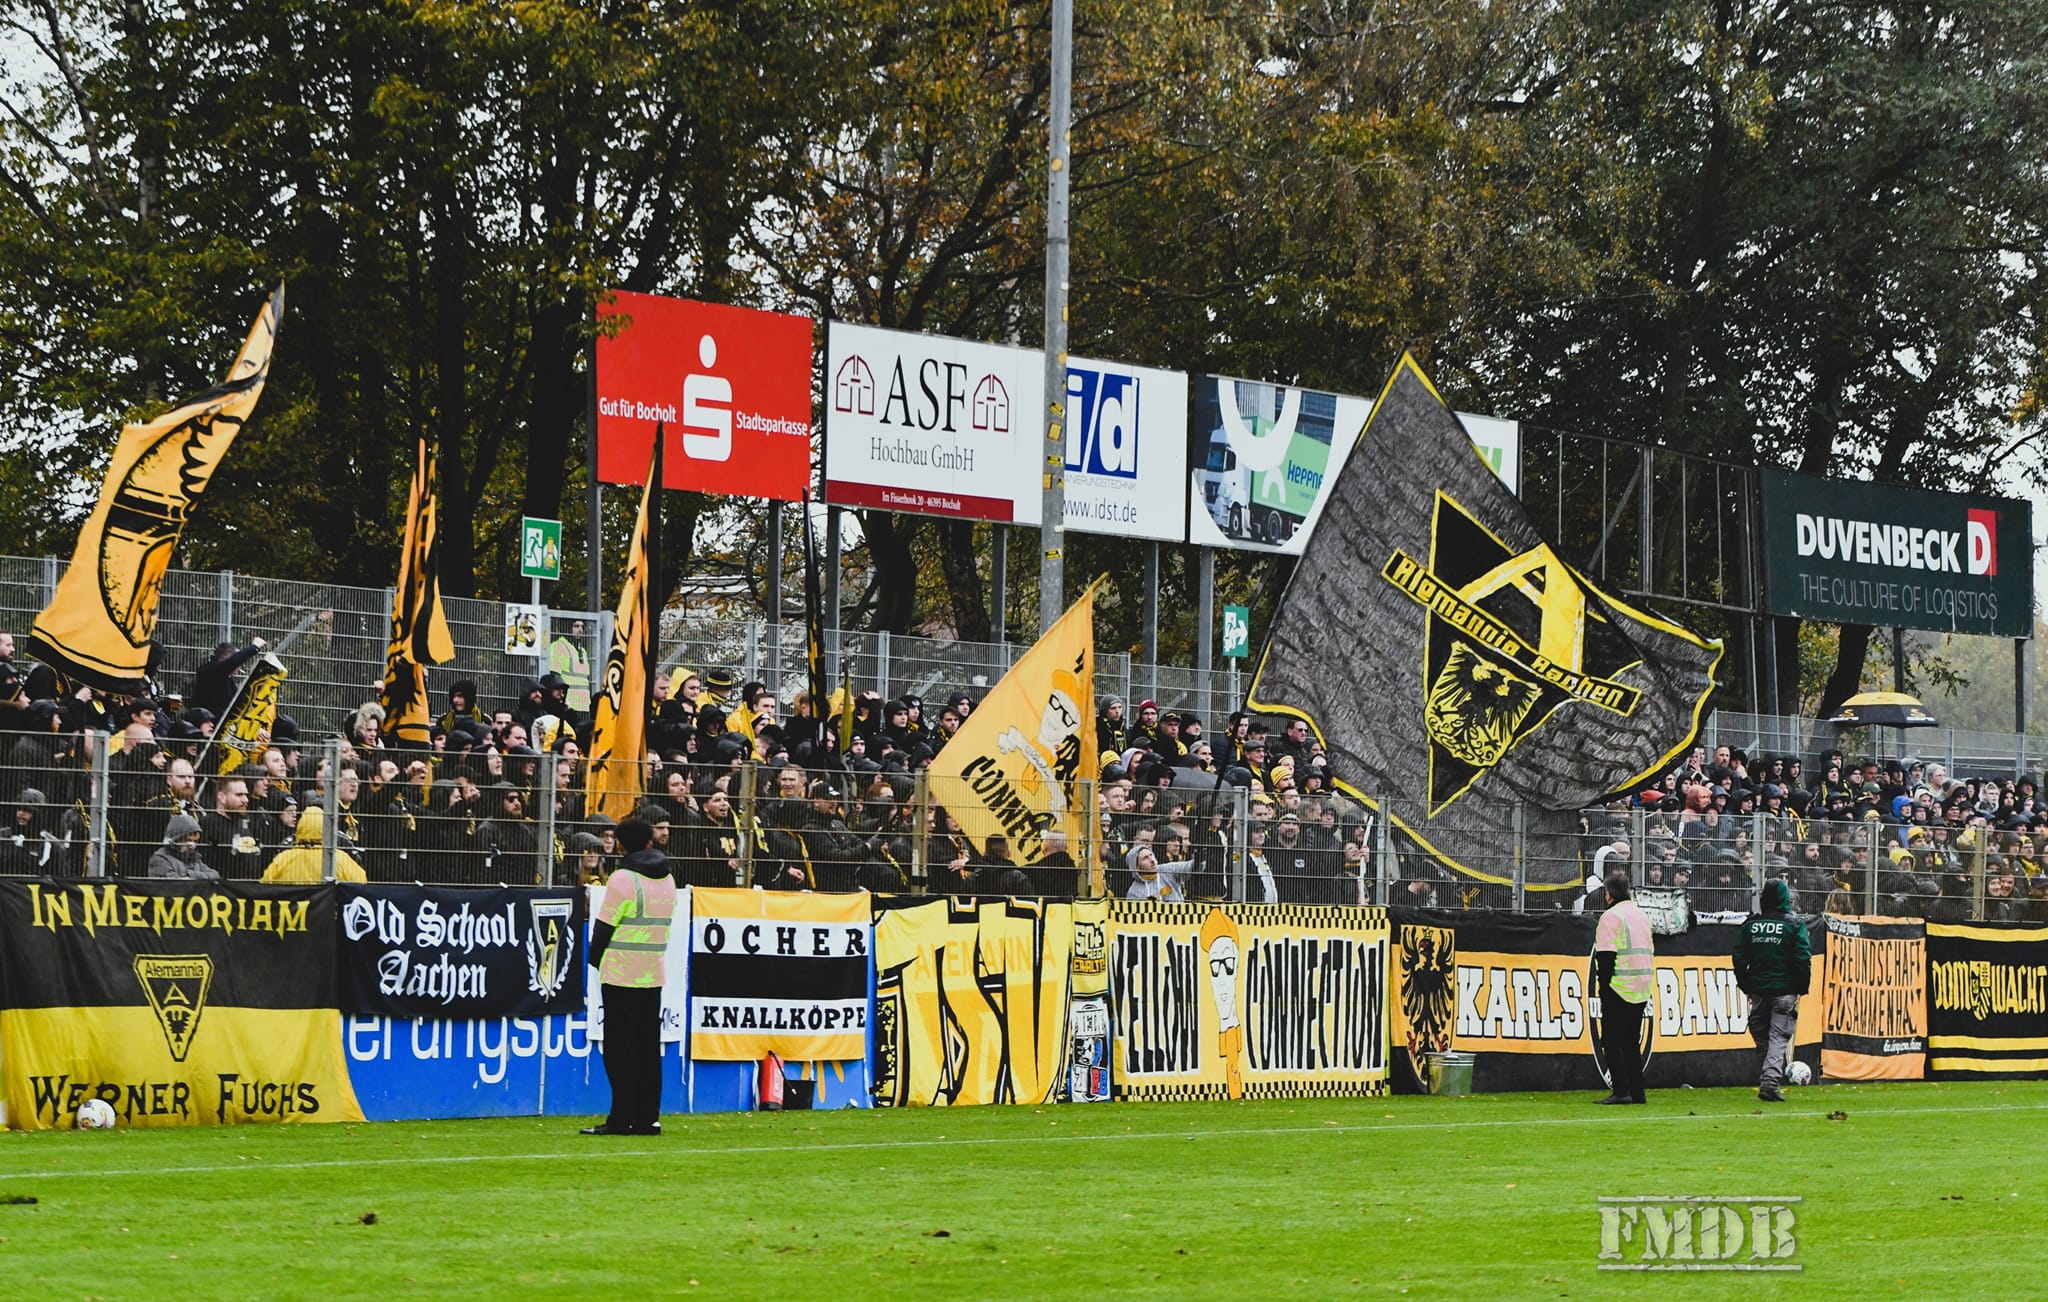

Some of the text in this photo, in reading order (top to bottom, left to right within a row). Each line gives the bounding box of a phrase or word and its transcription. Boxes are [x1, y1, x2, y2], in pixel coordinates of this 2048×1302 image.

[599, 397, 677, 423] Gut für Bocholt
[880, 355, 967, 432] ASF
[736, 411, 808, 436] Stadtsparkasse
[871, 437, 974, 471] Hochbau GmbH
[1796, 513, 1961, 573] DUVENBECK
[1799, 574, 1997, 621] THE CULTURE OF LOGISTICS
[1393, 556, 1627, 707] Alemannia Aachen
[343, 896, 520, 954] Old School
[703, 918, 866, 956] ÖCHER
[1751, 923, 1784, 935] SYDE
[1752, 935, 1783, 945] Security
[145, 962, 204, 977] Alemannia
[377, 950, 488, 1006] Aachen
[1831, 934, 1921, 987] FREUNDSCHAFT
[1111, 934, 1385, 1073] YELLOW CONNECTION
[1456, 966, 1752, 1040] KARLS BAND
[1932, 960, 2048, 1014] DOM WACHT
[701, 1004, 866, 1031] KNALLKÖPPE
